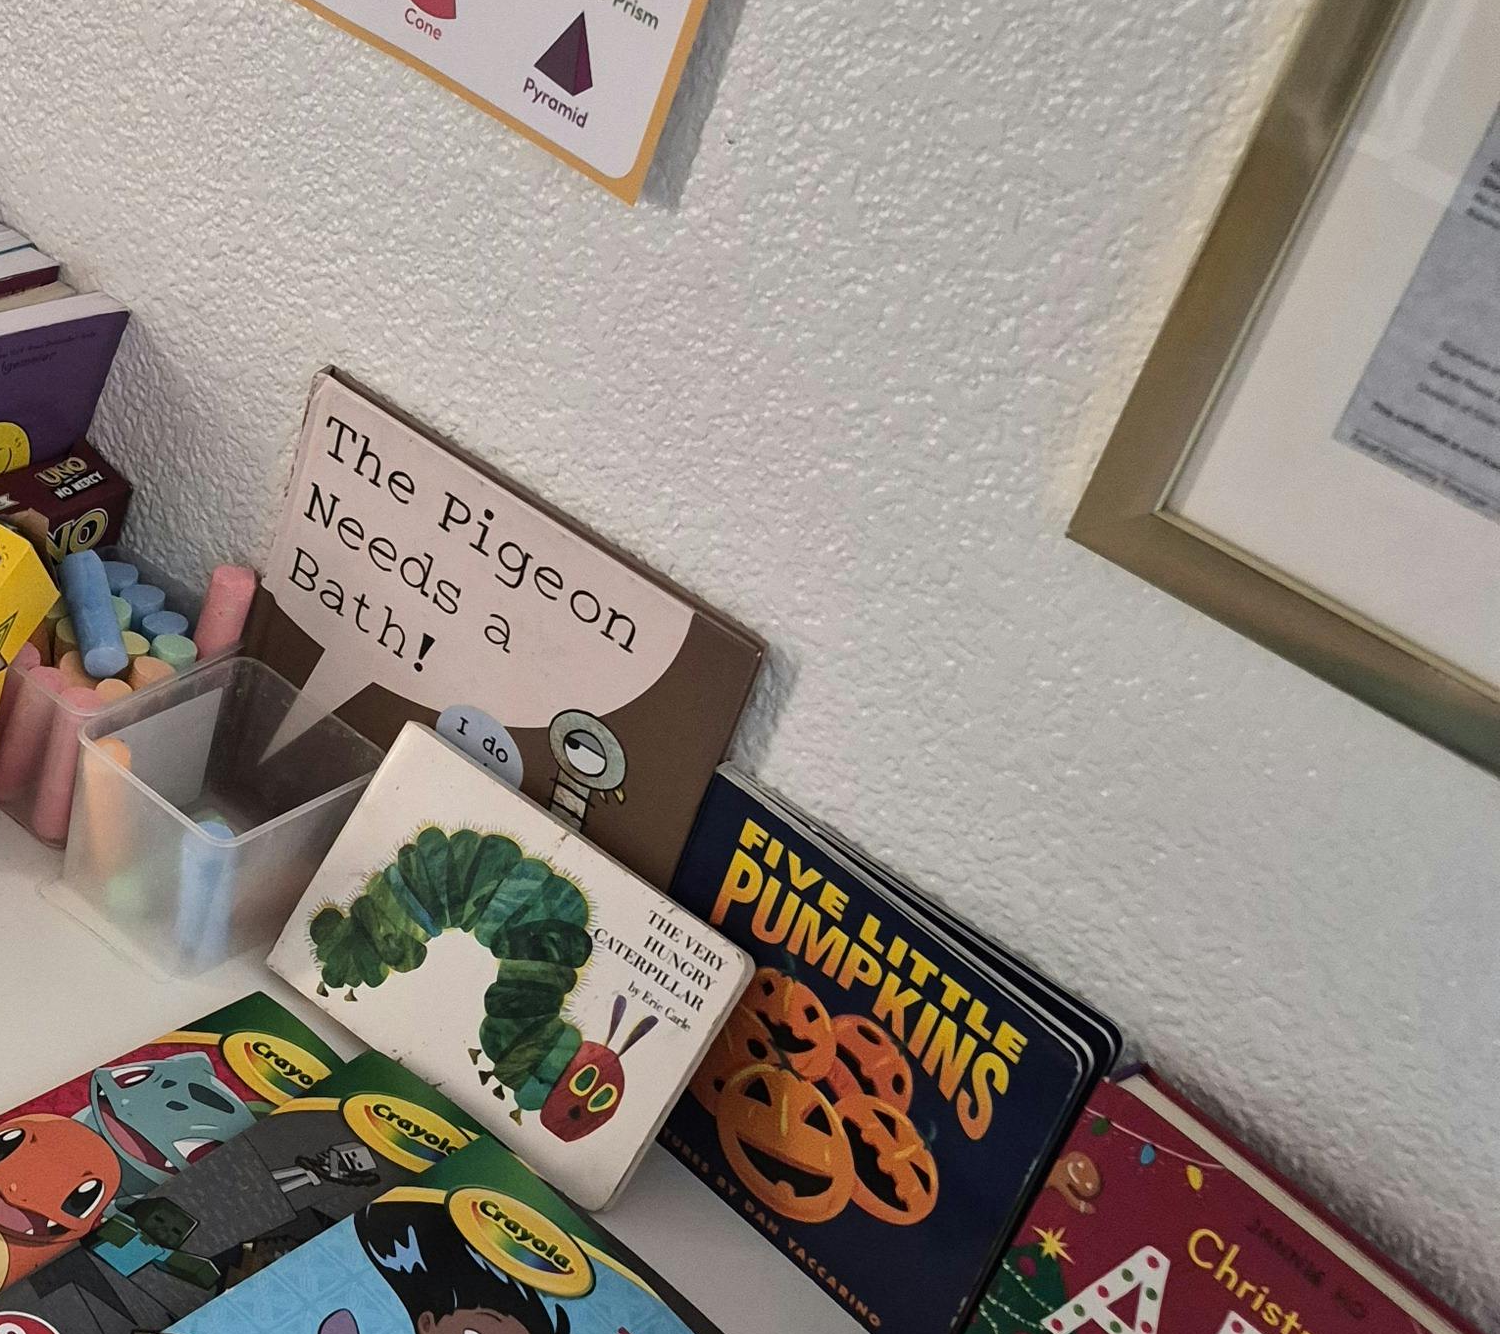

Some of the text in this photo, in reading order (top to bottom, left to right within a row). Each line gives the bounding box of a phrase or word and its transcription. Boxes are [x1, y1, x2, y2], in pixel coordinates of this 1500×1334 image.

[404, 7, 444, 42] Cone
[522, 76, 589, 130] Pyramid
[34, 456, 88, 488] UNO
[53, 471, 104, 500] NO MERCY
[325, 416, 637, 655] The Pigeon
[303, 482, 512, 653] Needs a
[288, 547, 436, 673] Bath!
[455, 716, 510, 765] I do
[594, 928, 704, 1013] CATERPILLAR
[643, 935, 718, 992] HUNGRY
[648, 910, 728, 972] THE VERY
[738, 817, 1029, 1066] FIVE LITTLE
[628, 980, 692, 1032] by Eric Carle
[710, 848, 1011, 1141] PUMPKINS
[252, 1040, 316, 1087] Crayo
[478, 1198, 573, 1274] Crayola
[787, 1235, 882, 1329] YACCARINO
